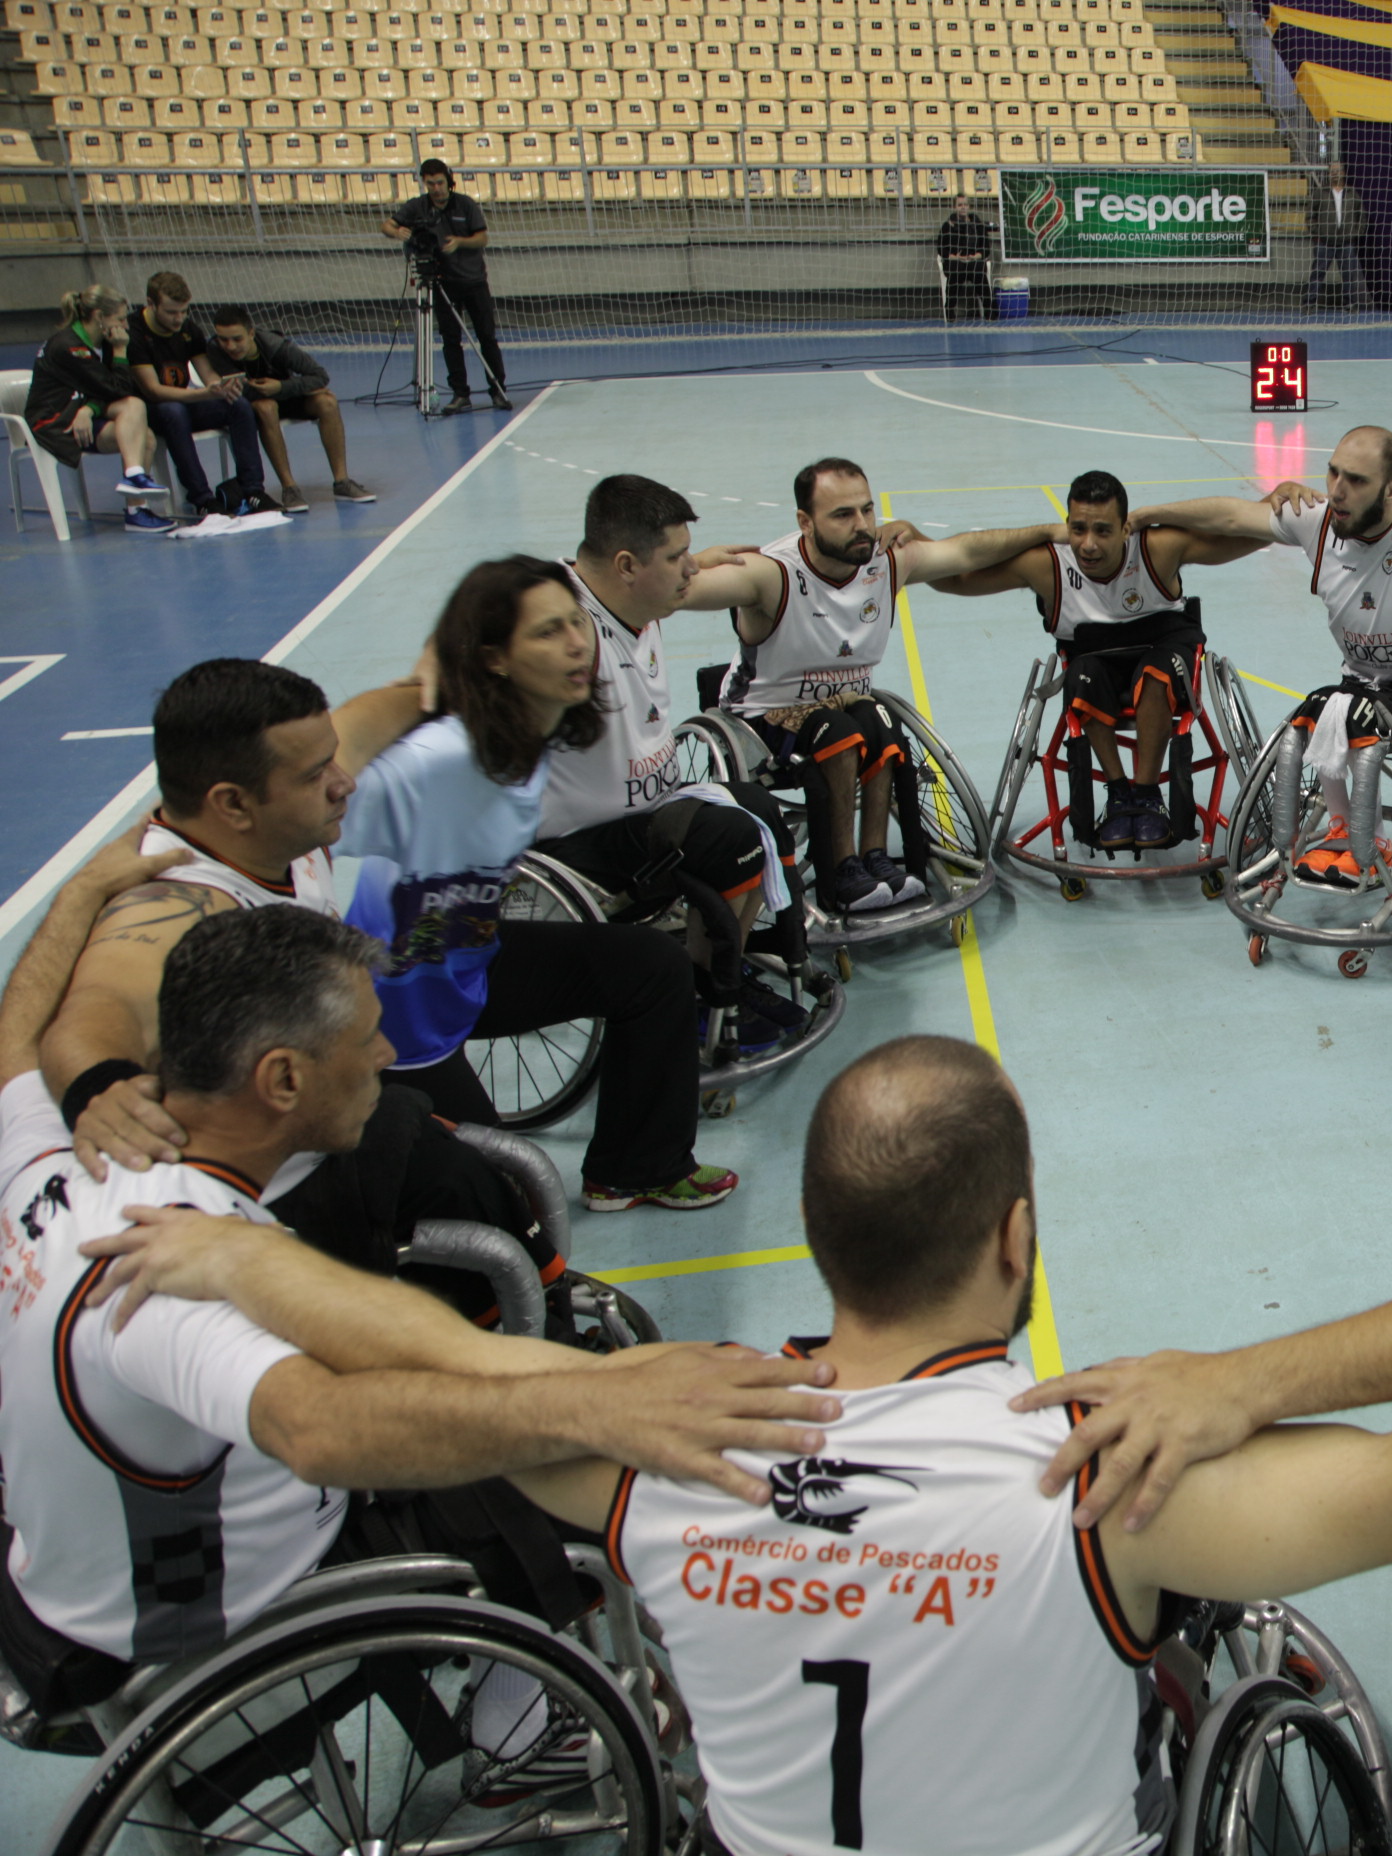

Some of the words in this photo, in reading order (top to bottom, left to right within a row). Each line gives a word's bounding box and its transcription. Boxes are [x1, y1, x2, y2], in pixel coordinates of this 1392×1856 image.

[1074, 187, 1247, 231] Fesporte
[1078, 232, 1126, 243] FUNDAÇÃO
[1128, 232, 1190, 243] CATARINENSE
[1192, 233, 1204, 242] DE
[1205, 232, 1245, 243] ESPORTE
[1257, 367, 1302, 399] 24
[803, 665, 871, 683] JOINVILLE
[681, 1525, 808, 1562] Comércio
[816, 1541, 851, 1564] de
[858, 1543, 1000, 1573] Pescados
[681, 1550, 867, 1619] Classe
[95, 1725, 155, 1795] KENDA
